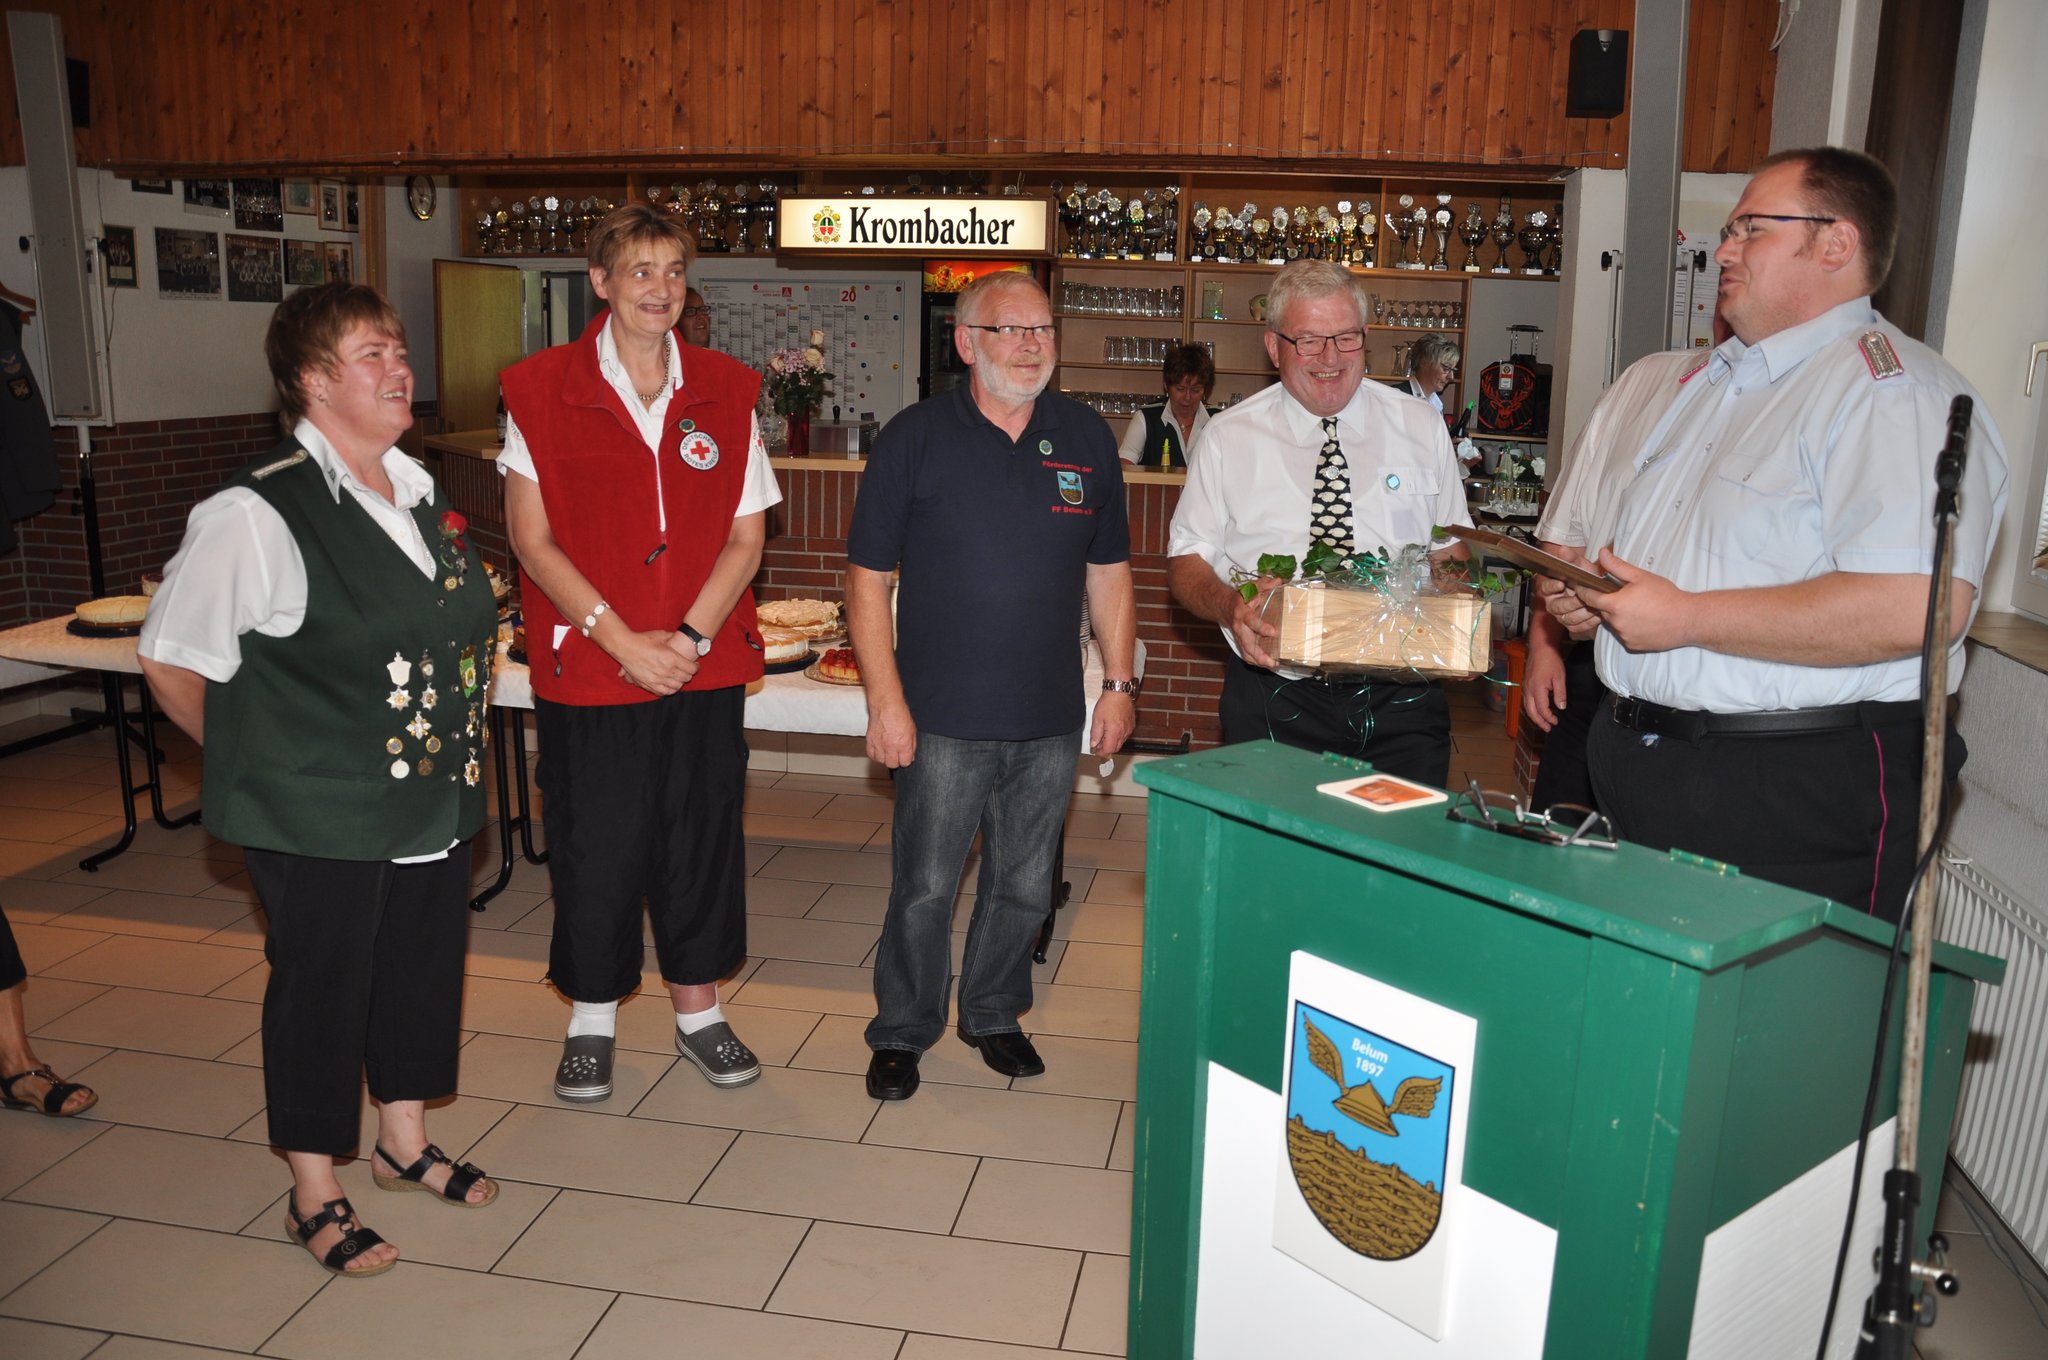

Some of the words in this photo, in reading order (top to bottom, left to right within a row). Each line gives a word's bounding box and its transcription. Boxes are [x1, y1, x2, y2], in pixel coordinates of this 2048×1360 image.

[849, 206, 1015, 245] Krombacher
[841, 290, 857, 303] 20
[1351, 1037, 1388, 1064] Belum
[1355, 1056, 1384, 1077] 1897
